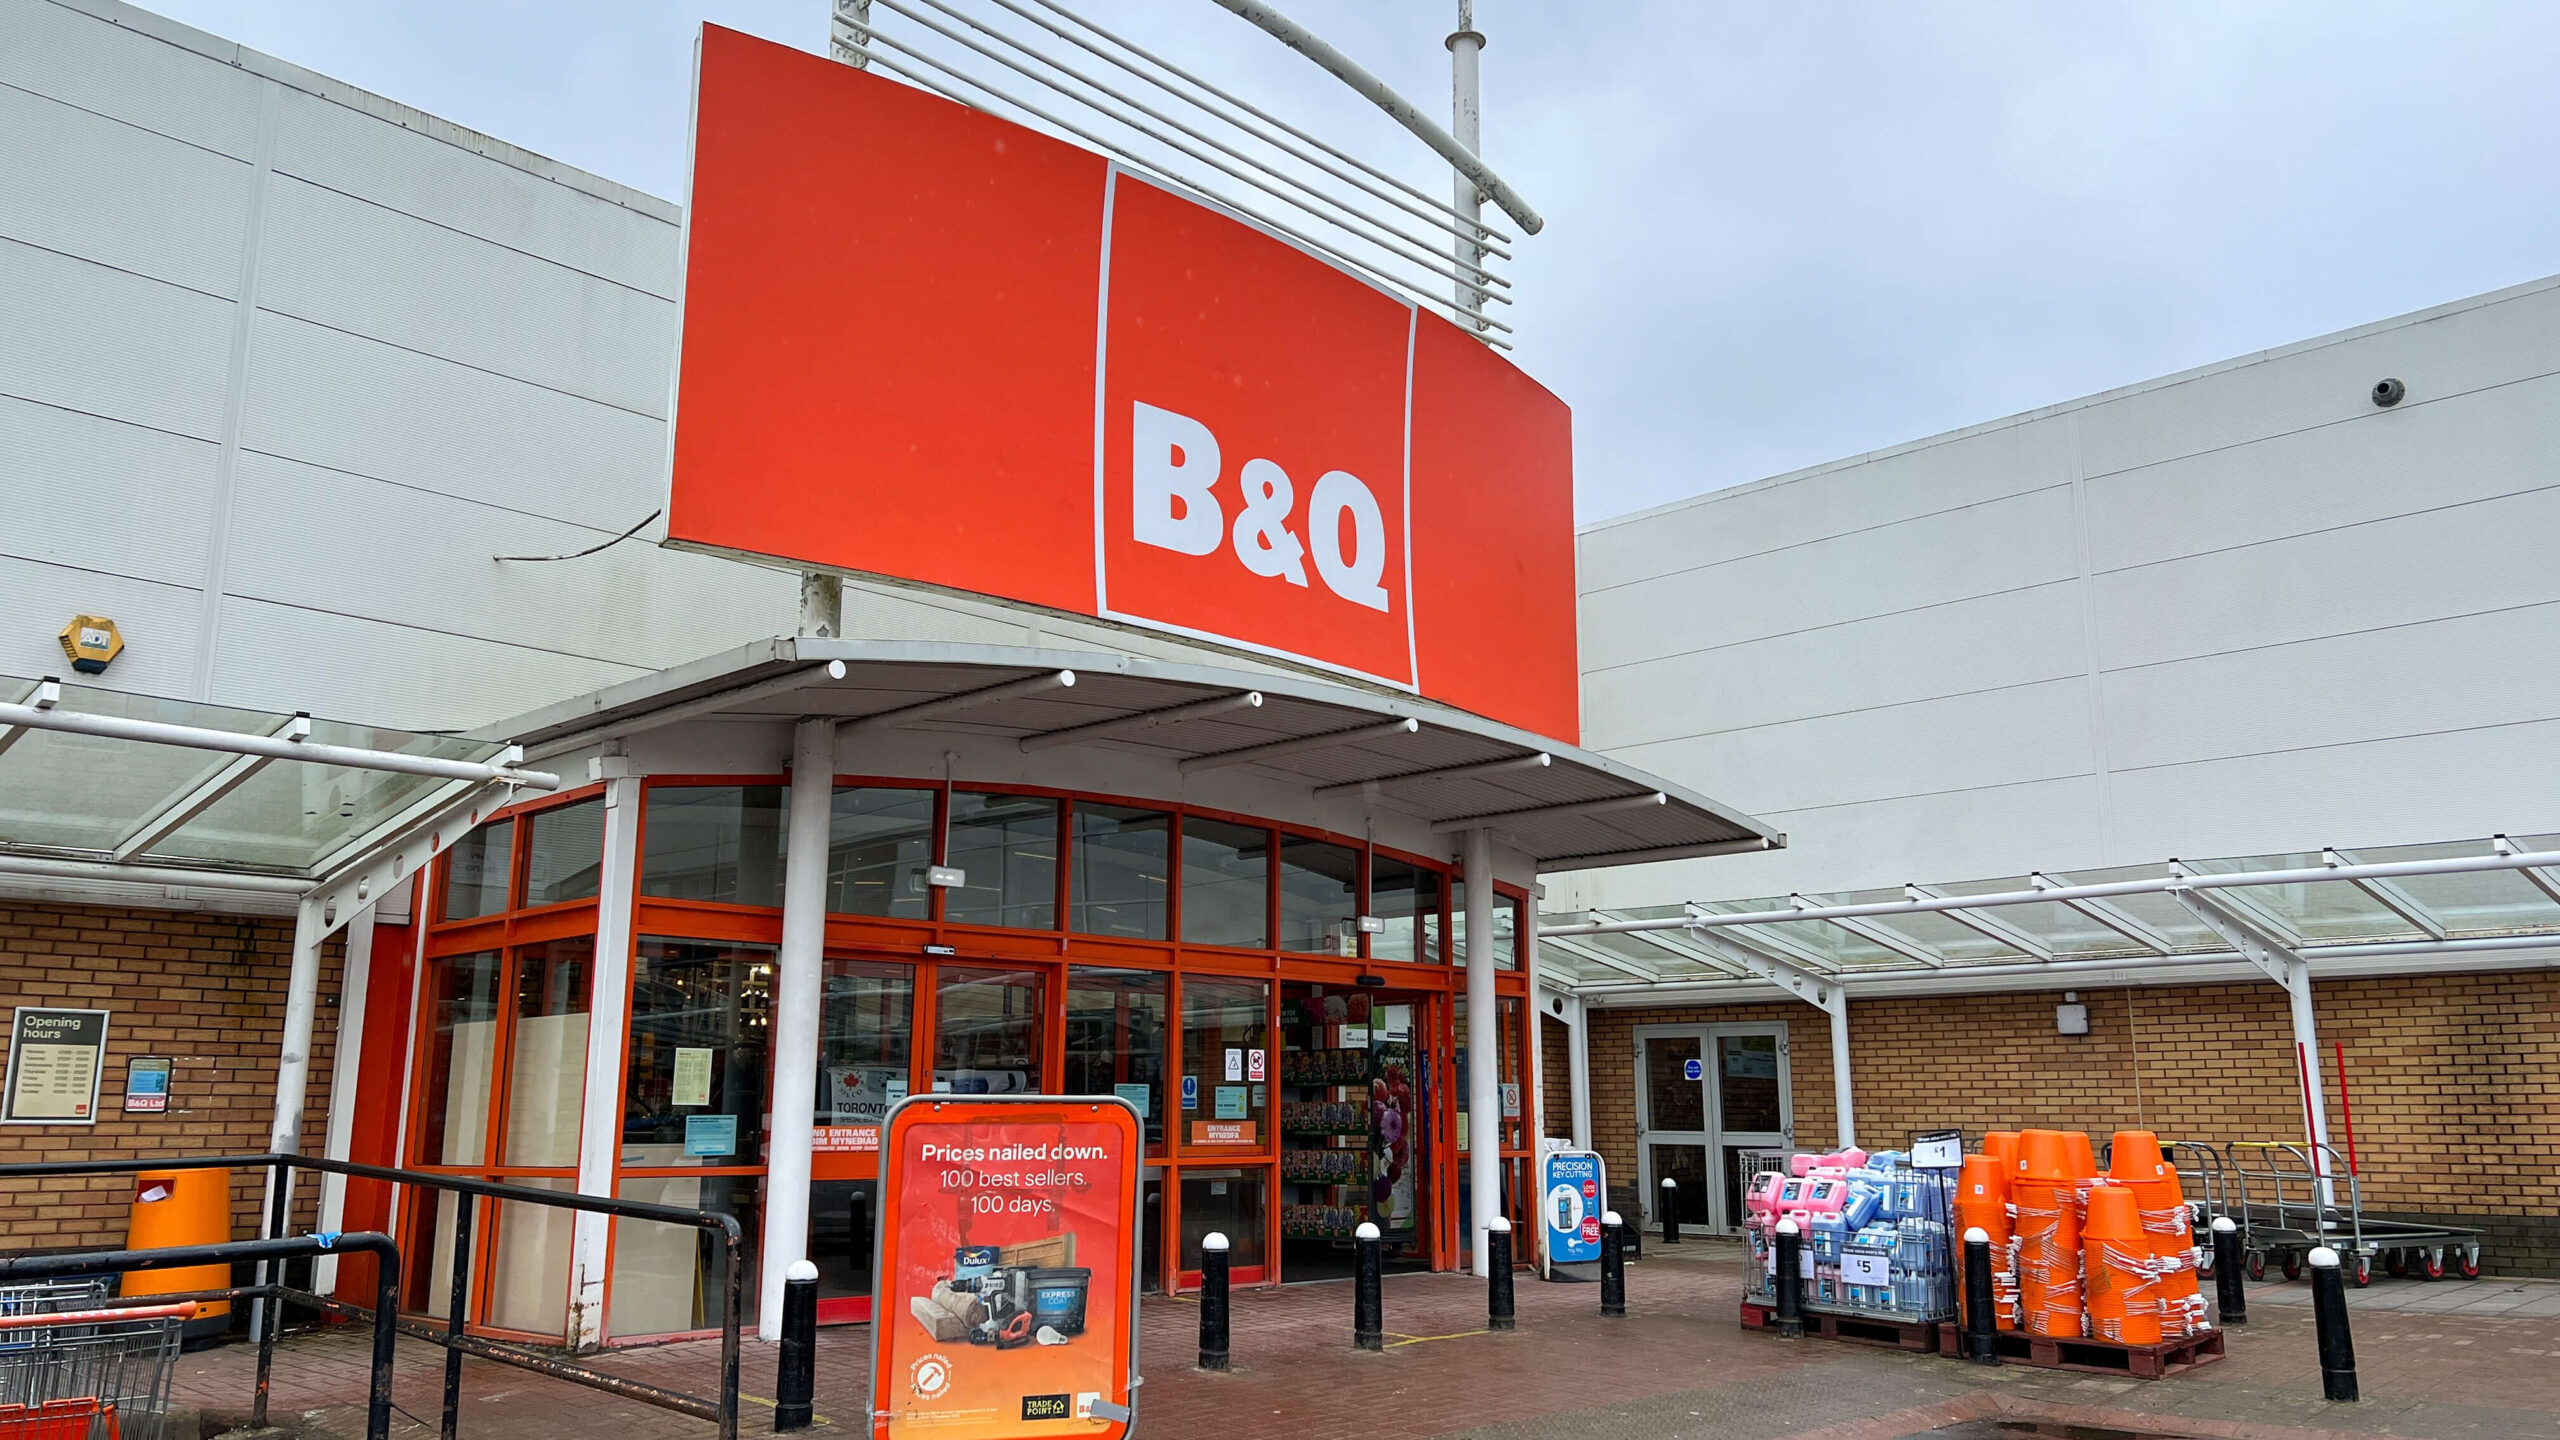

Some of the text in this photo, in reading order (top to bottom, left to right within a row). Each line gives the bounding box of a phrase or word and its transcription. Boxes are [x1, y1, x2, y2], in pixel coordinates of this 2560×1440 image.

[1133, 399, 1390, 614] B&Q
[25, 1015, 81, 1030] Opening
[23, 1027, 62, 1039] hours
[128, 1099, 165, 1107] B&Q Ltd
[813, 1128, 877, 1137] NO ENTRANCE
[1207, 1124, 1241, 1132] ENTRANCE
[830, 1137, 879, 1146] MYNEDIAD
[921, 1143, 1108, 1161] Prices nailed down.
[1552, 1161, 1593, 1171] PRECISION
[940, 1169, 1088, 1188] 100 best sellers.
[1552, 1170, 1593, 1179] KEY CUTTING
[971, 1195, 1056, 1217] 100 days.
[1582, 1226, 1599, 1236] FREE
[963, 1256, 987, 1265] Dulux
[1857, 1260, 1872, 1273] £5
[1041, 1290, 1076, 1298] EXPRESS
[910, 1353, 953, 1371] Prices nailed
[1027, 1399, 1053, 1408] TRADE
[1026, 1407, 1052, 1416] POINT
